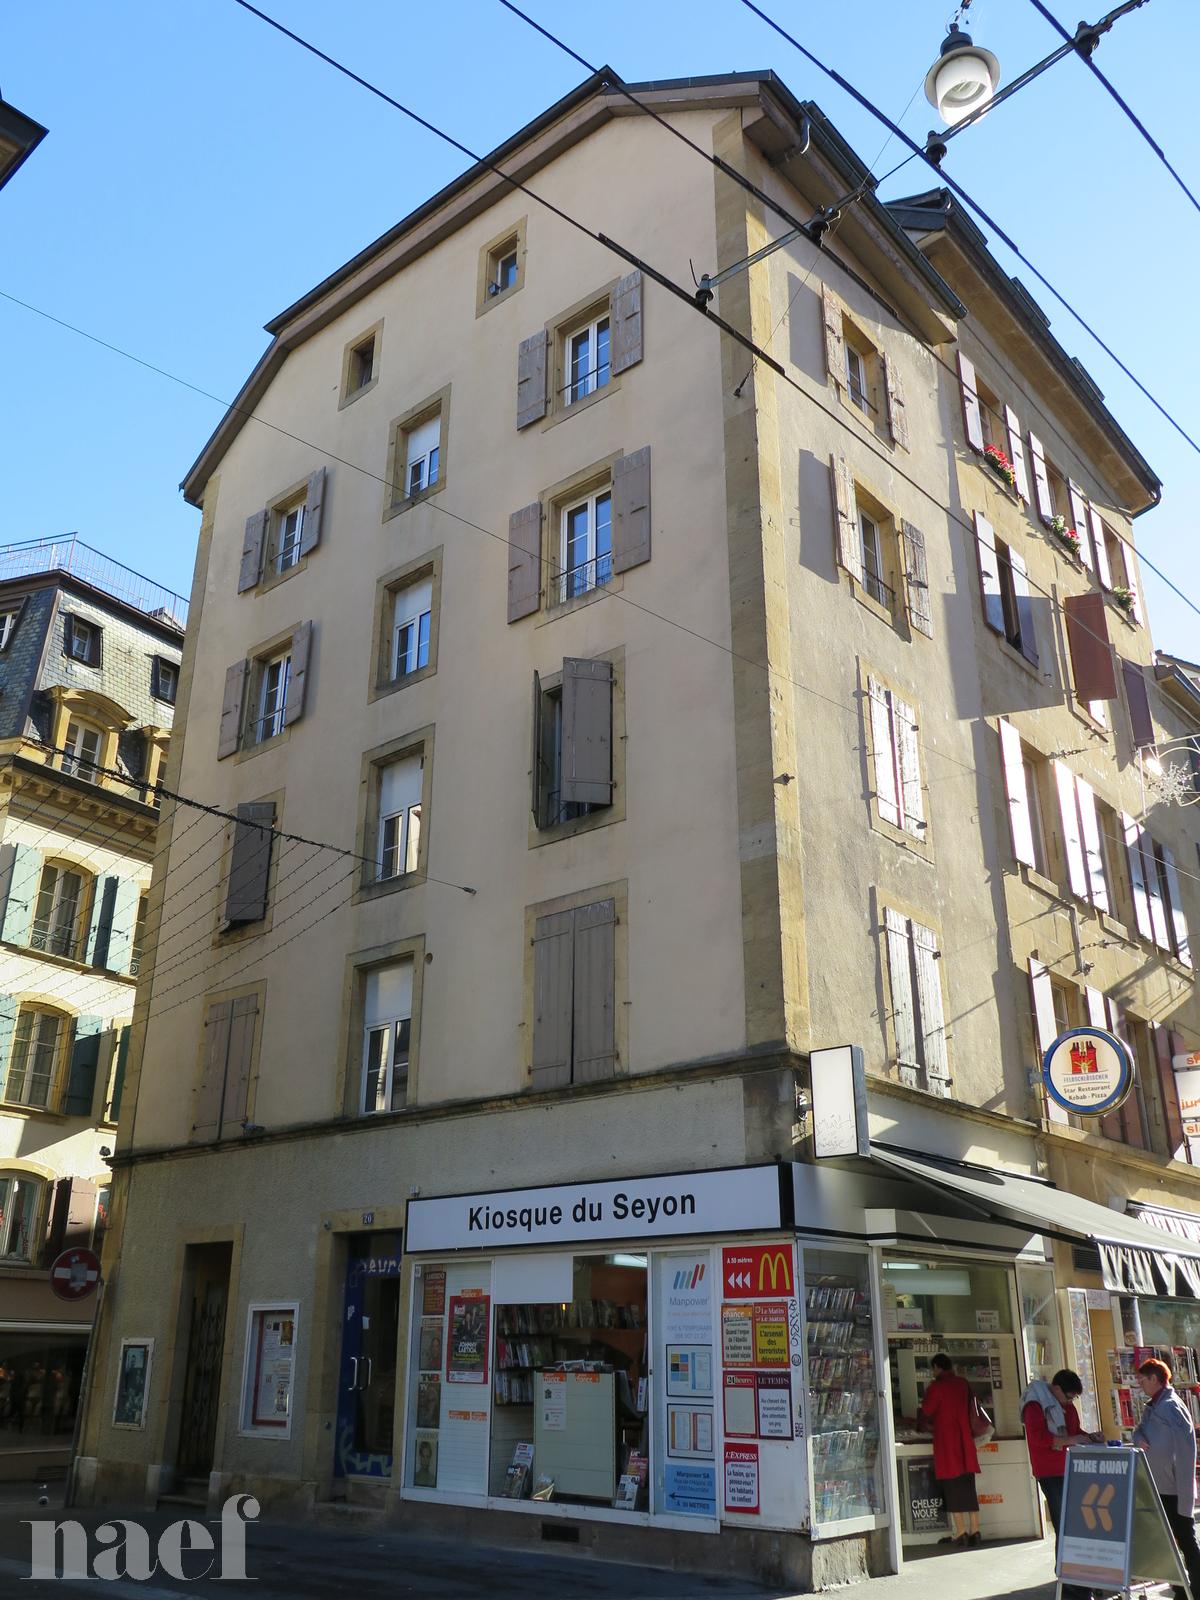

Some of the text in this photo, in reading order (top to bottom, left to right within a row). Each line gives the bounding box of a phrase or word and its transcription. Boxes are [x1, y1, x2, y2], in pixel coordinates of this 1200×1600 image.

[468, 1193, 696, 1232] Kiosque du Seyon
[669, 1296, 708, 1306] Manpower
[768, 1307, 785, 1315] Matin
[759, 1347, 787, 1355] terroristes
[757, 1377, 789, 1385] LE TEMPS
[725, 1451, 757, 1460] L'EXPRESS
[1073, 1459, 1129, 1475] TAKE AWAY
[737, 1487, 754, 1495] habitants
[737, 1495, 752, 1503] confient
[912, 1509, 938, 1519] WOLFE
